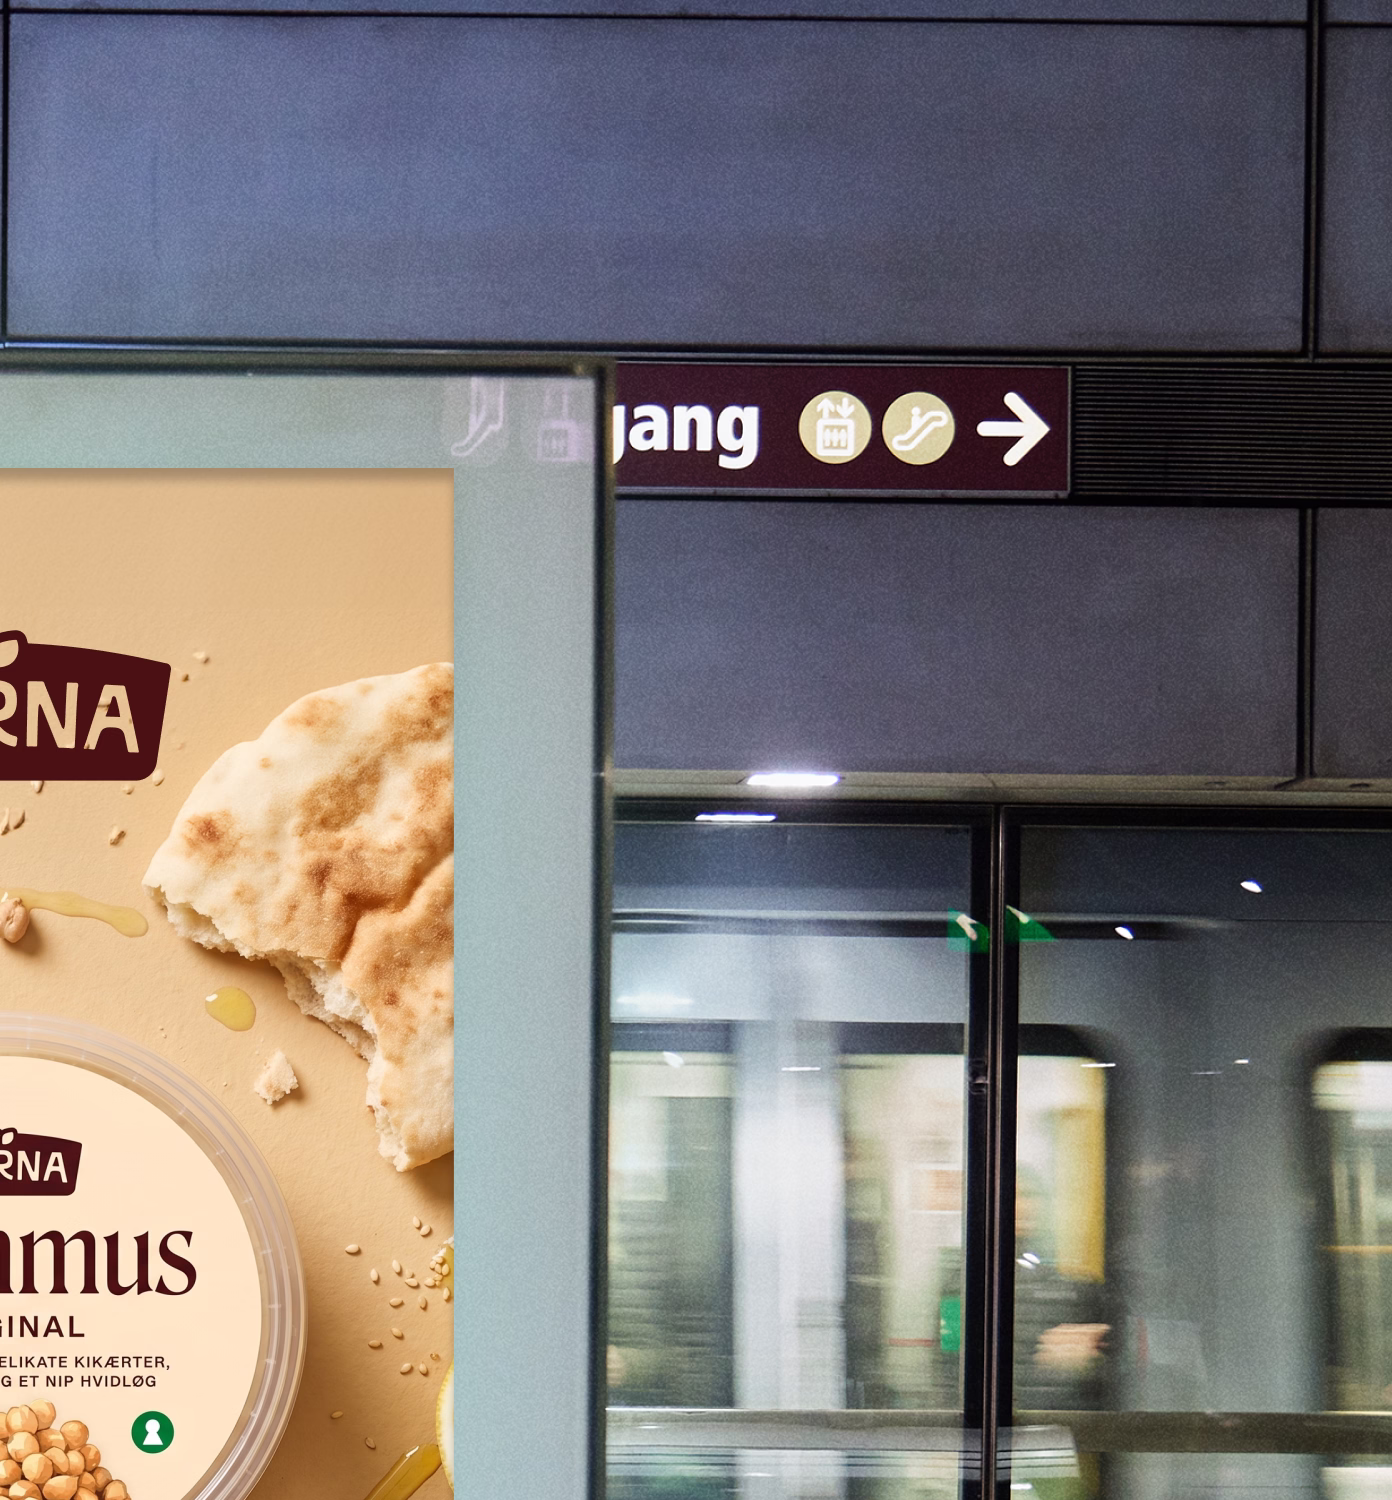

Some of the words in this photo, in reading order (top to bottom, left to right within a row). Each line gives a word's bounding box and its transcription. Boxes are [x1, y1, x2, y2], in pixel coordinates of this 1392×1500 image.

[75, 1356, 171, 1371] KIKÆRTER,
[19, 1375, 39, 1388] ET
[45, 1375, 75, 1388] NIP
[80, 1375, 157, 1388] HVIDLØG
